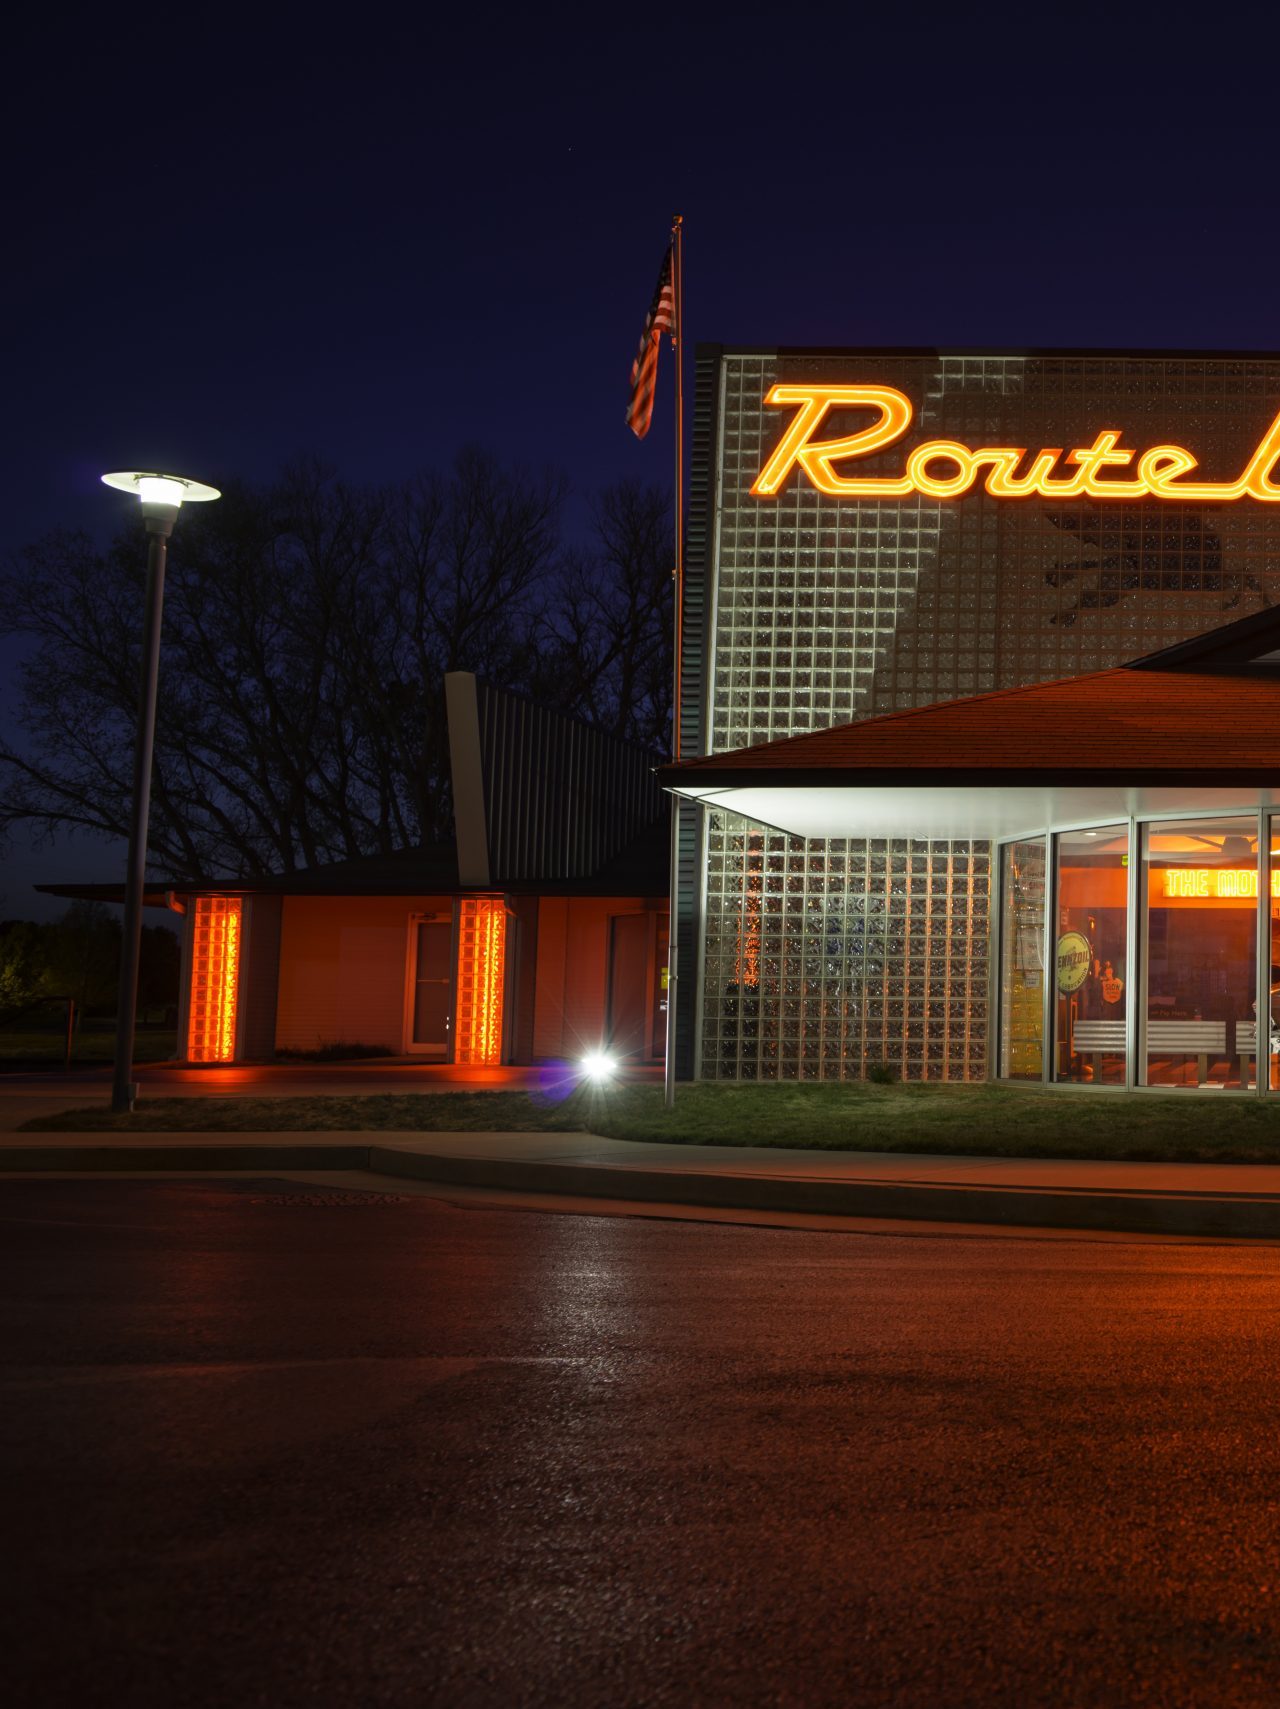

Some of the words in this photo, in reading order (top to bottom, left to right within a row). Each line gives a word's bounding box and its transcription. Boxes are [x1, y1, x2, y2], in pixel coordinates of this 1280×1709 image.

[750, 384, 1246, 498] Route
[1166, 870, 1208, 897] THE
[1057, 950, 1089, 969] ENNZOIL
